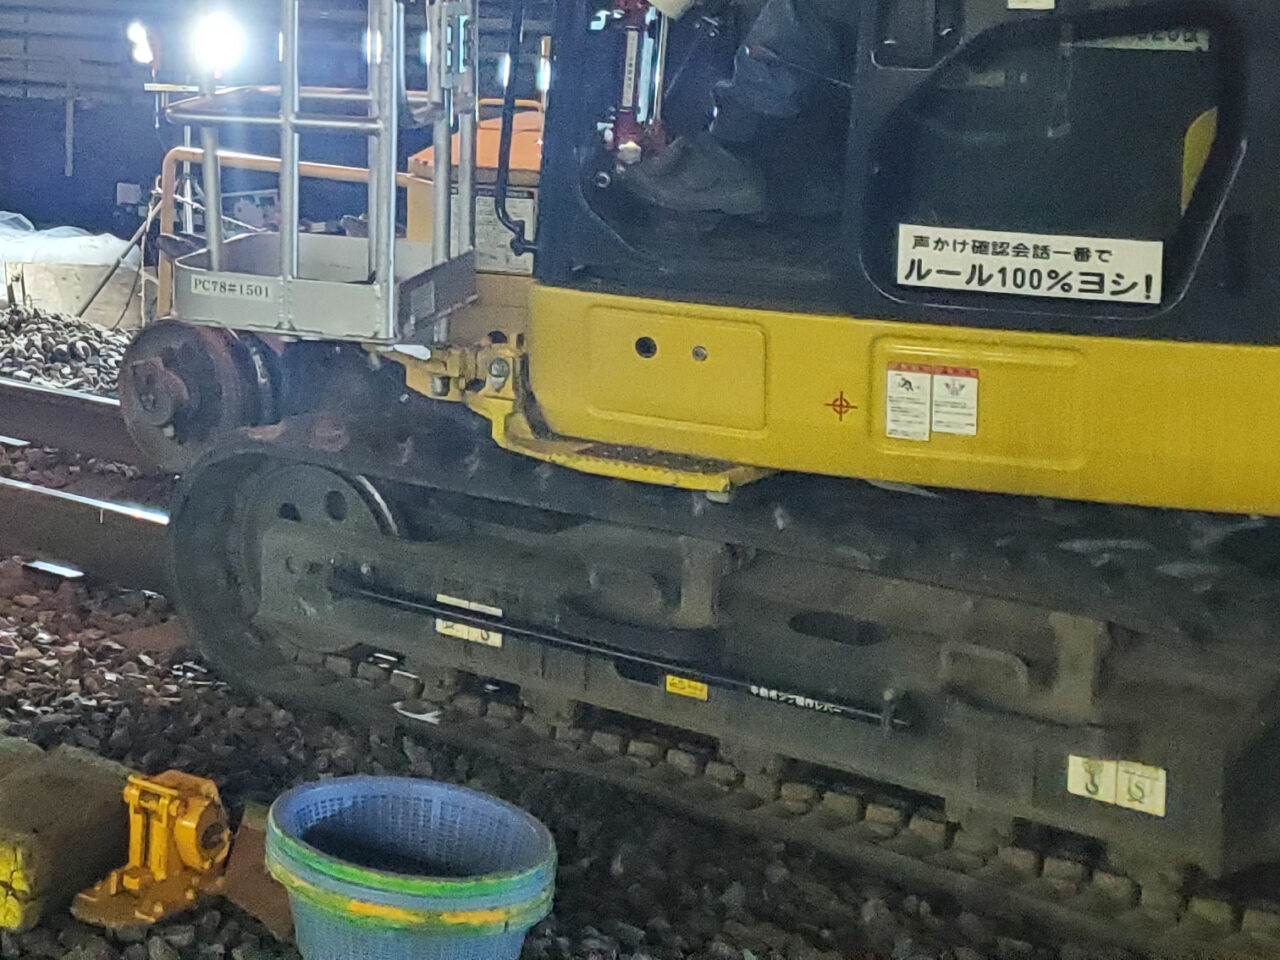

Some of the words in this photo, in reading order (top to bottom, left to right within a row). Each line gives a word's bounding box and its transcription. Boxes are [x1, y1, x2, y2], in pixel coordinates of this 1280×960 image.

[911, 234, 1114, 263] 声かけ確認会話一番で
[193, 279, 270, 299] PC78#1501
